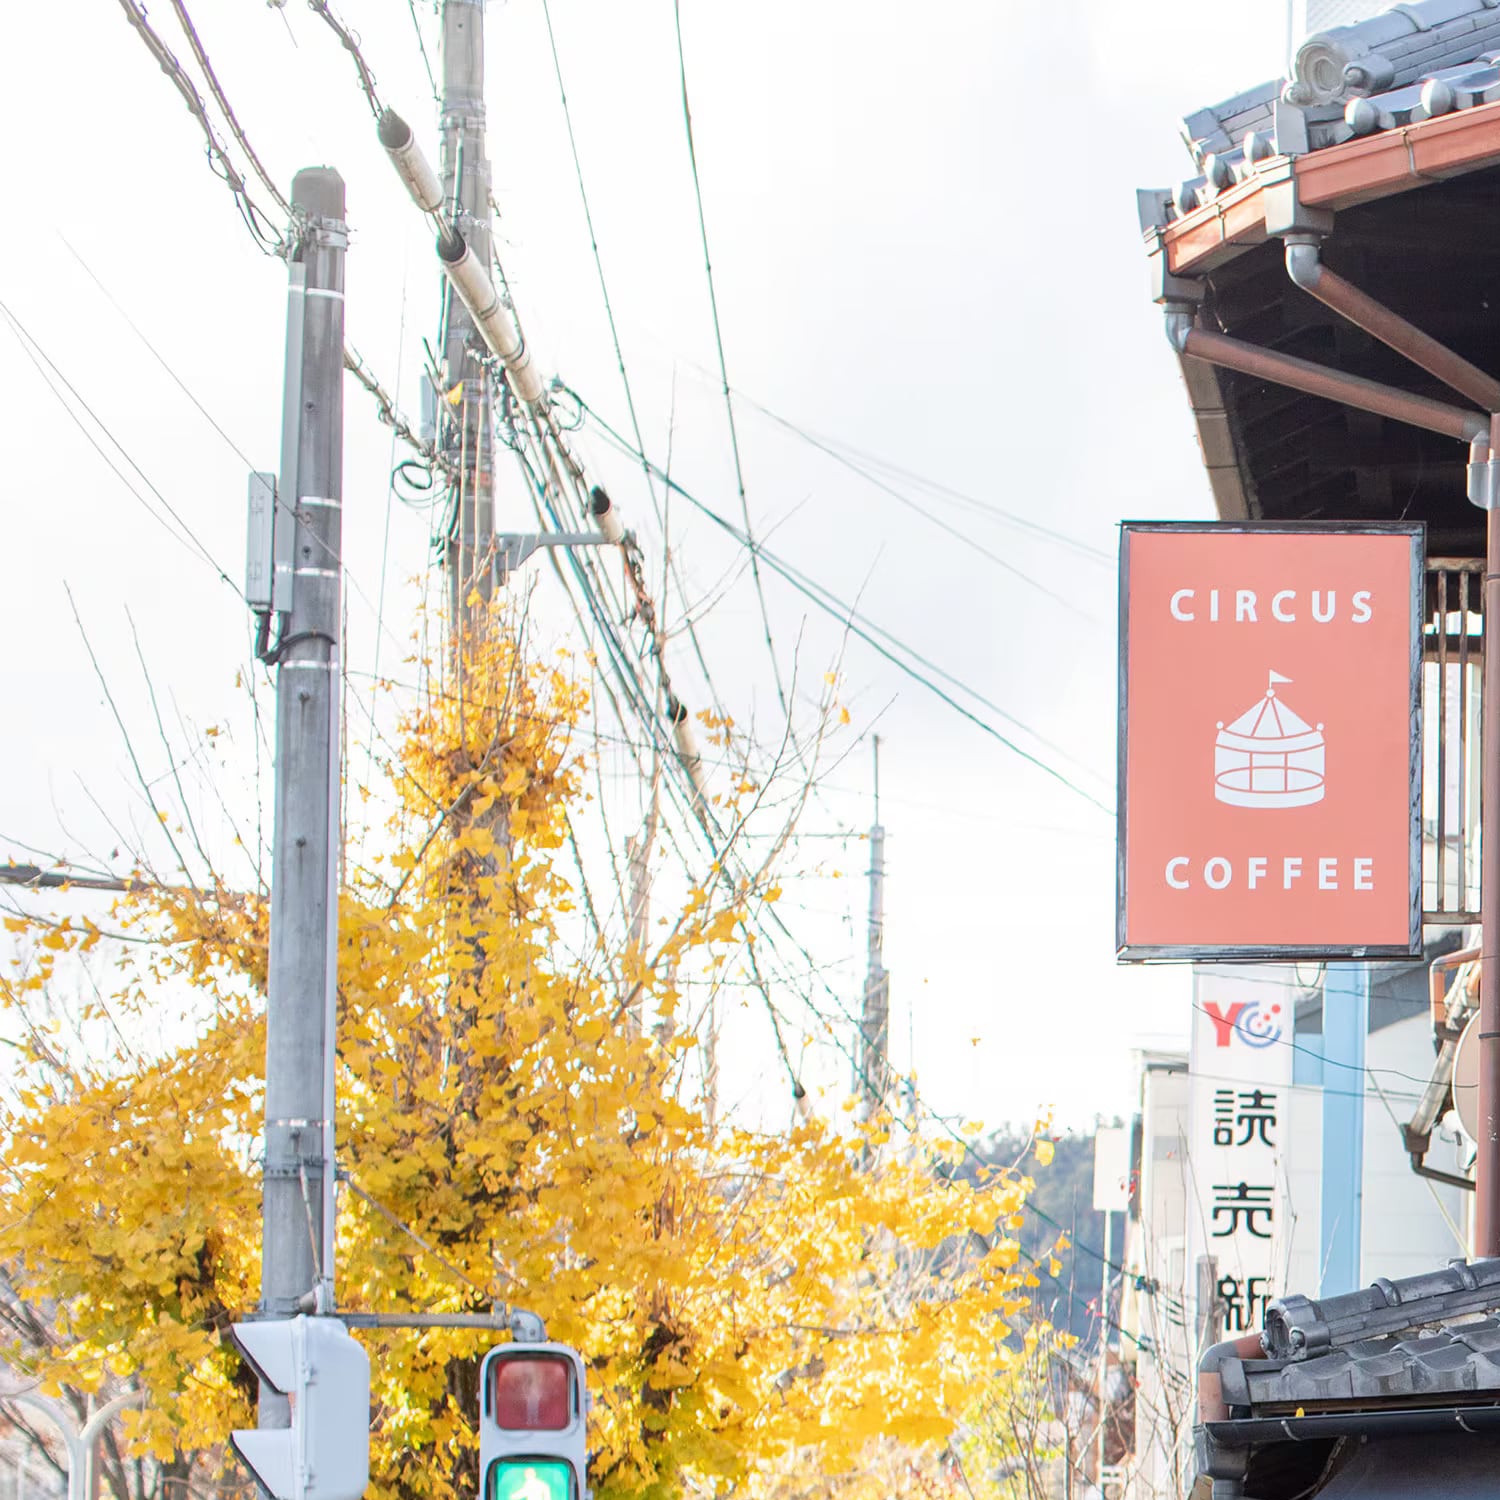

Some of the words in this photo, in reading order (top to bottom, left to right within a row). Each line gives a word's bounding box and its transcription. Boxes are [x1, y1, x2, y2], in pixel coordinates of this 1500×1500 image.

[1169, 588, 1373, 623] CIRCUS
[1164, 856, 1375, 891] COFFEE
[1211, 1089, 1277, 1331] 読売新
